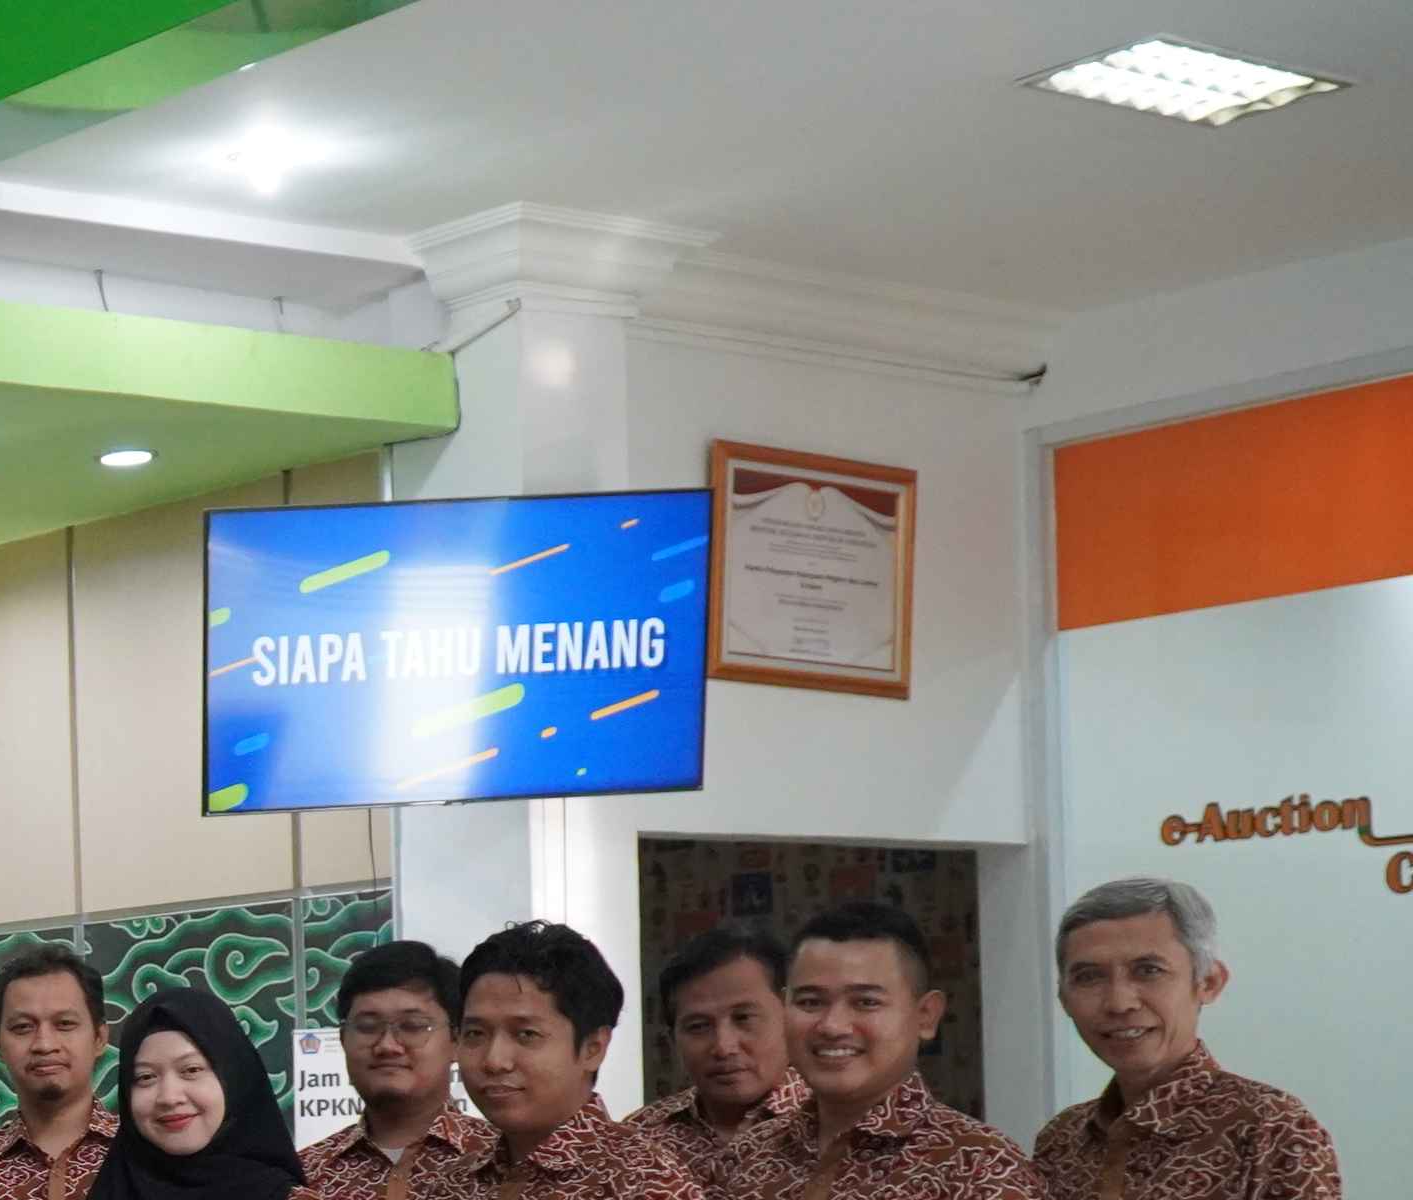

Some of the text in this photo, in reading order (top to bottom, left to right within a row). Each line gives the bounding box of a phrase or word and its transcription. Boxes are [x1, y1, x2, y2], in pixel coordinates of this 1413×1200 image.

[251, 617, 665, 686] SIAPA TAHU MENANG
[1160, 794, 1371, 846] e-Auction
[299, 1070, 341, 1091] Jam
